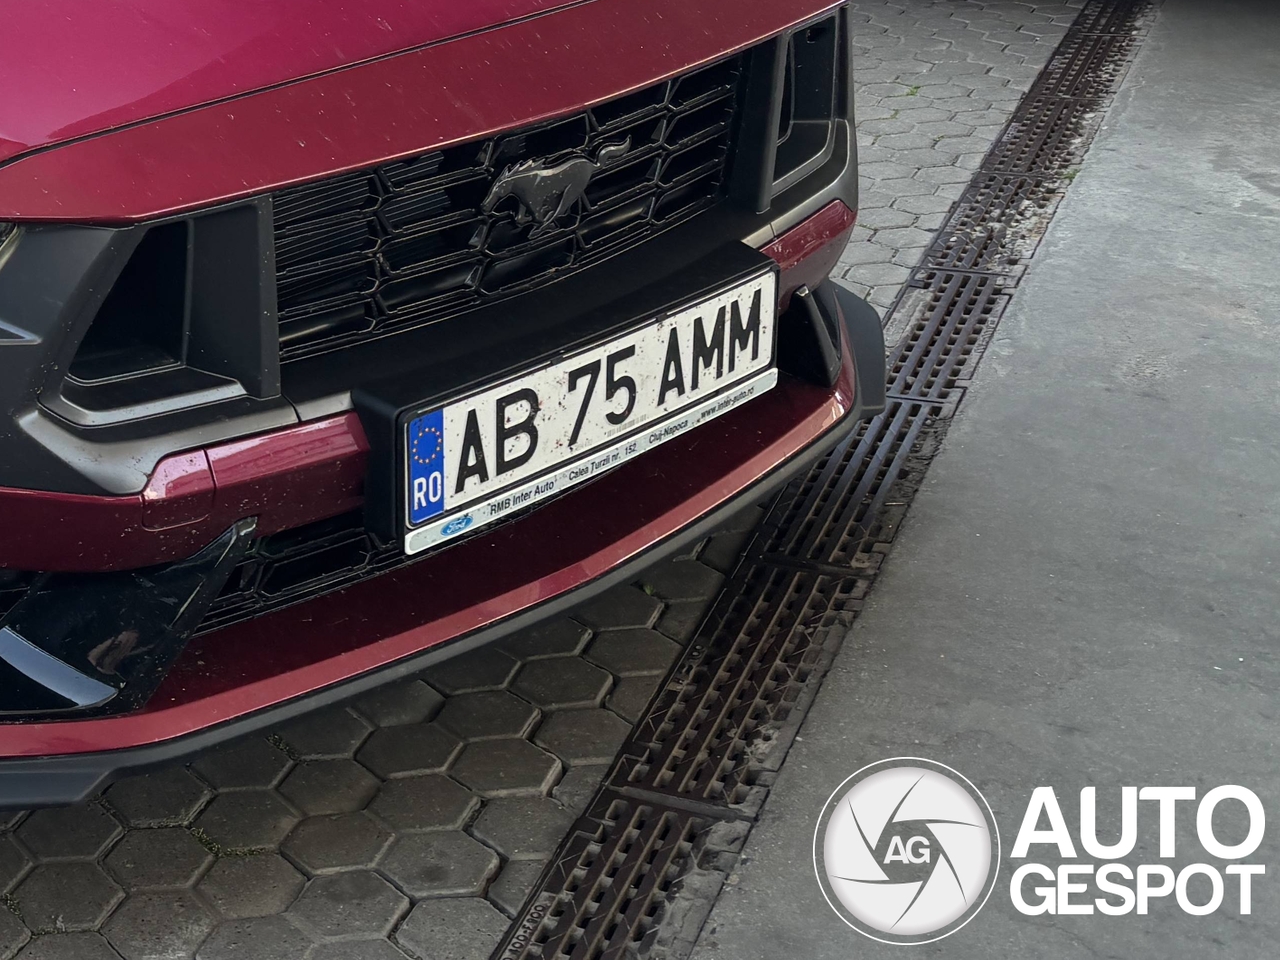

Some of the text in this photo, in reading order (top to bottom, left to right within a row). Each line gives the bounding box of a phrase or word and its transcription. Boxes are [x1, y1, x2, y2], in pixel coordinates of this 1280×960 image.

[454, 287, 762, 495] AB 75 AMM
[413, 470, 442, 511] RO
[489, 499, 511, 516] RMB
[512, 491, 532, 507] Inter
[533, 482, 555, 497] Auto
[568, 466, 589, 481] Calea
[624, 443, 637, 456] 152
